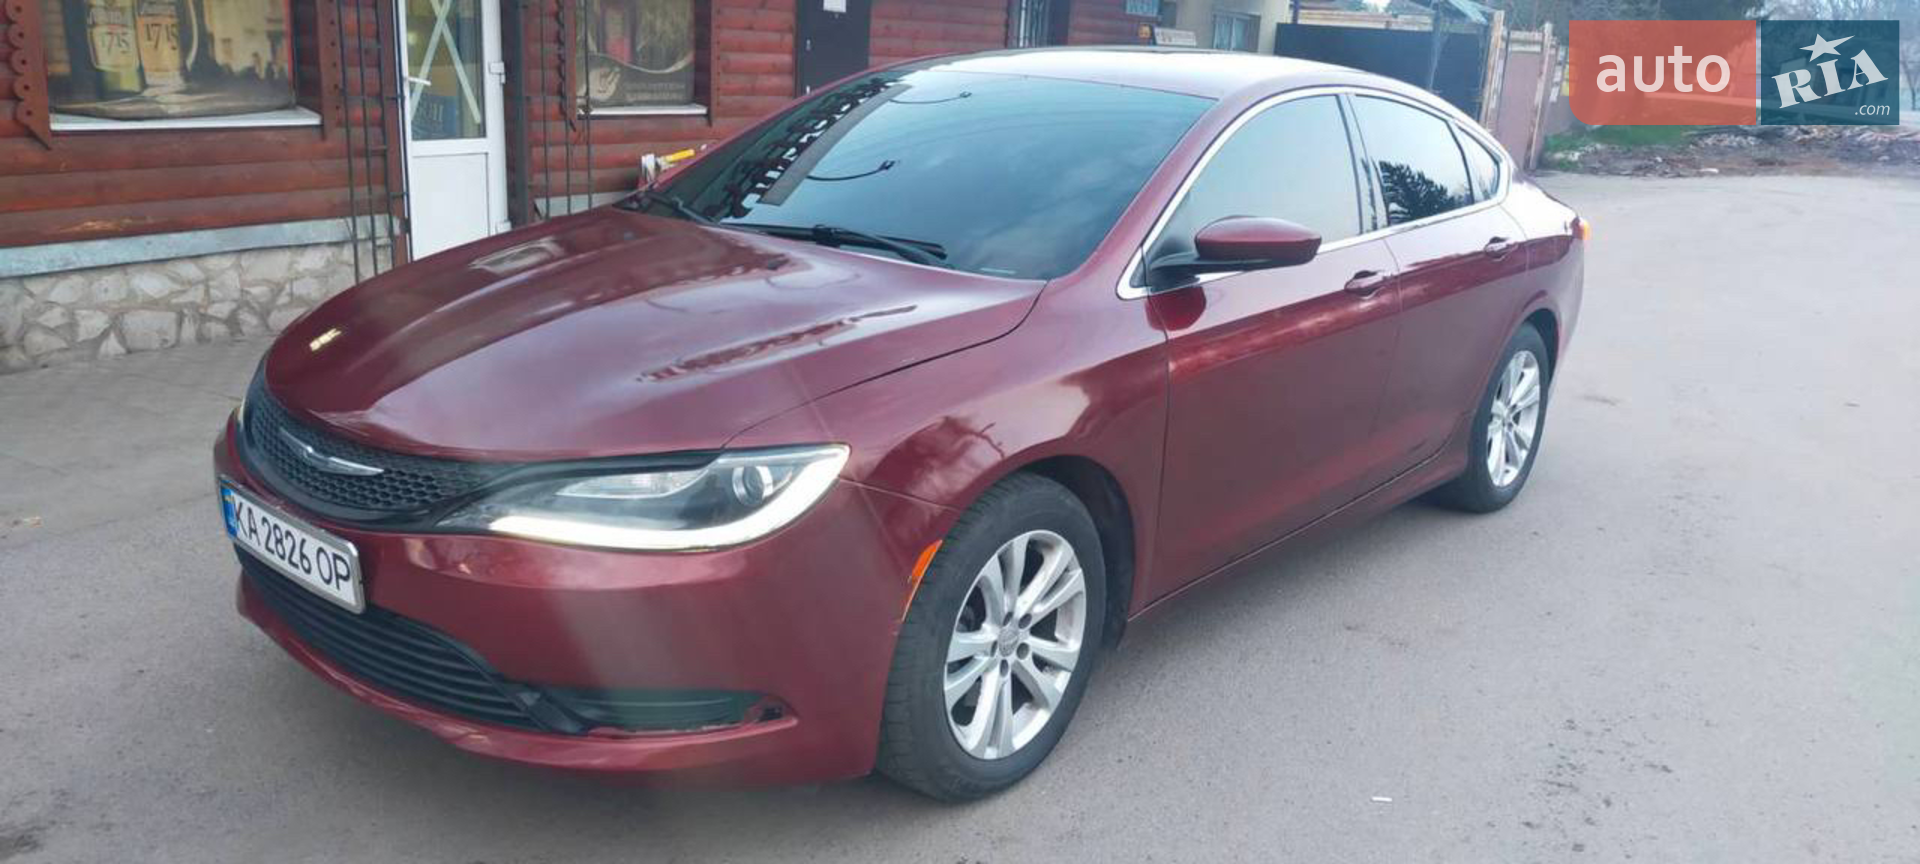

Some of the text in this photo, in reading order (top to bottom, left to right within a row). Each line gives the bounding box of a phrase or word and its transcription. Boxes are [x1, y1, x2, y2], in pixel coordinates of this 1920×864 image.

[145, 22, 178, 51] 1715
[235, 502, 351, 590] KA 2826 OP
